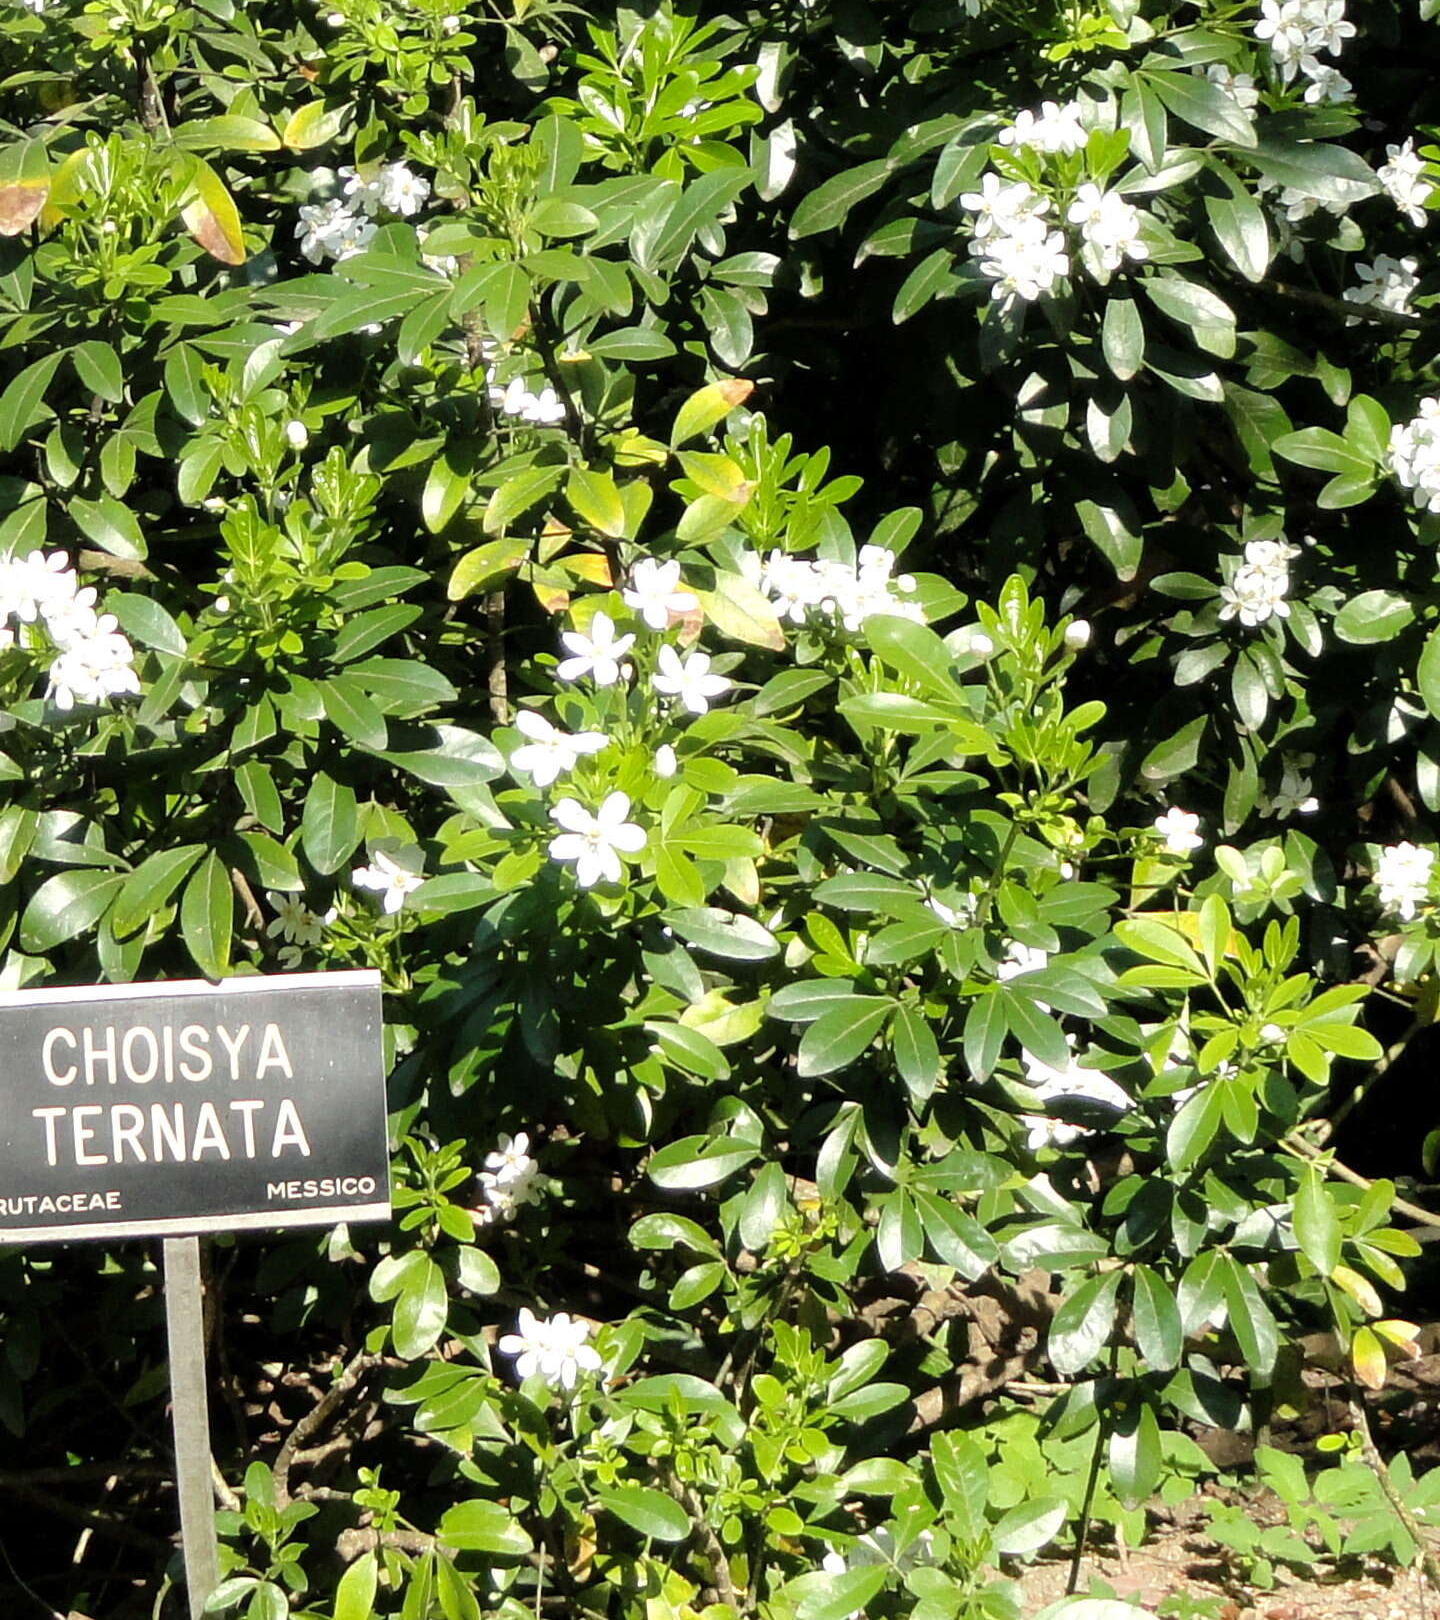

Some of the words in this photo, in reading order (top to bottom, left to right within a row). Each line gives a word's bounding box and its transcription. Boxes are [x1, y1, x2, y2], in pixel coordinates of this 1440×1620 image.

[42, 1023, 293, 1086] CHOISYA
[32, 1099, 311, 1166] TERNATA
[267, 1177, 376, 1200] MESSICO
